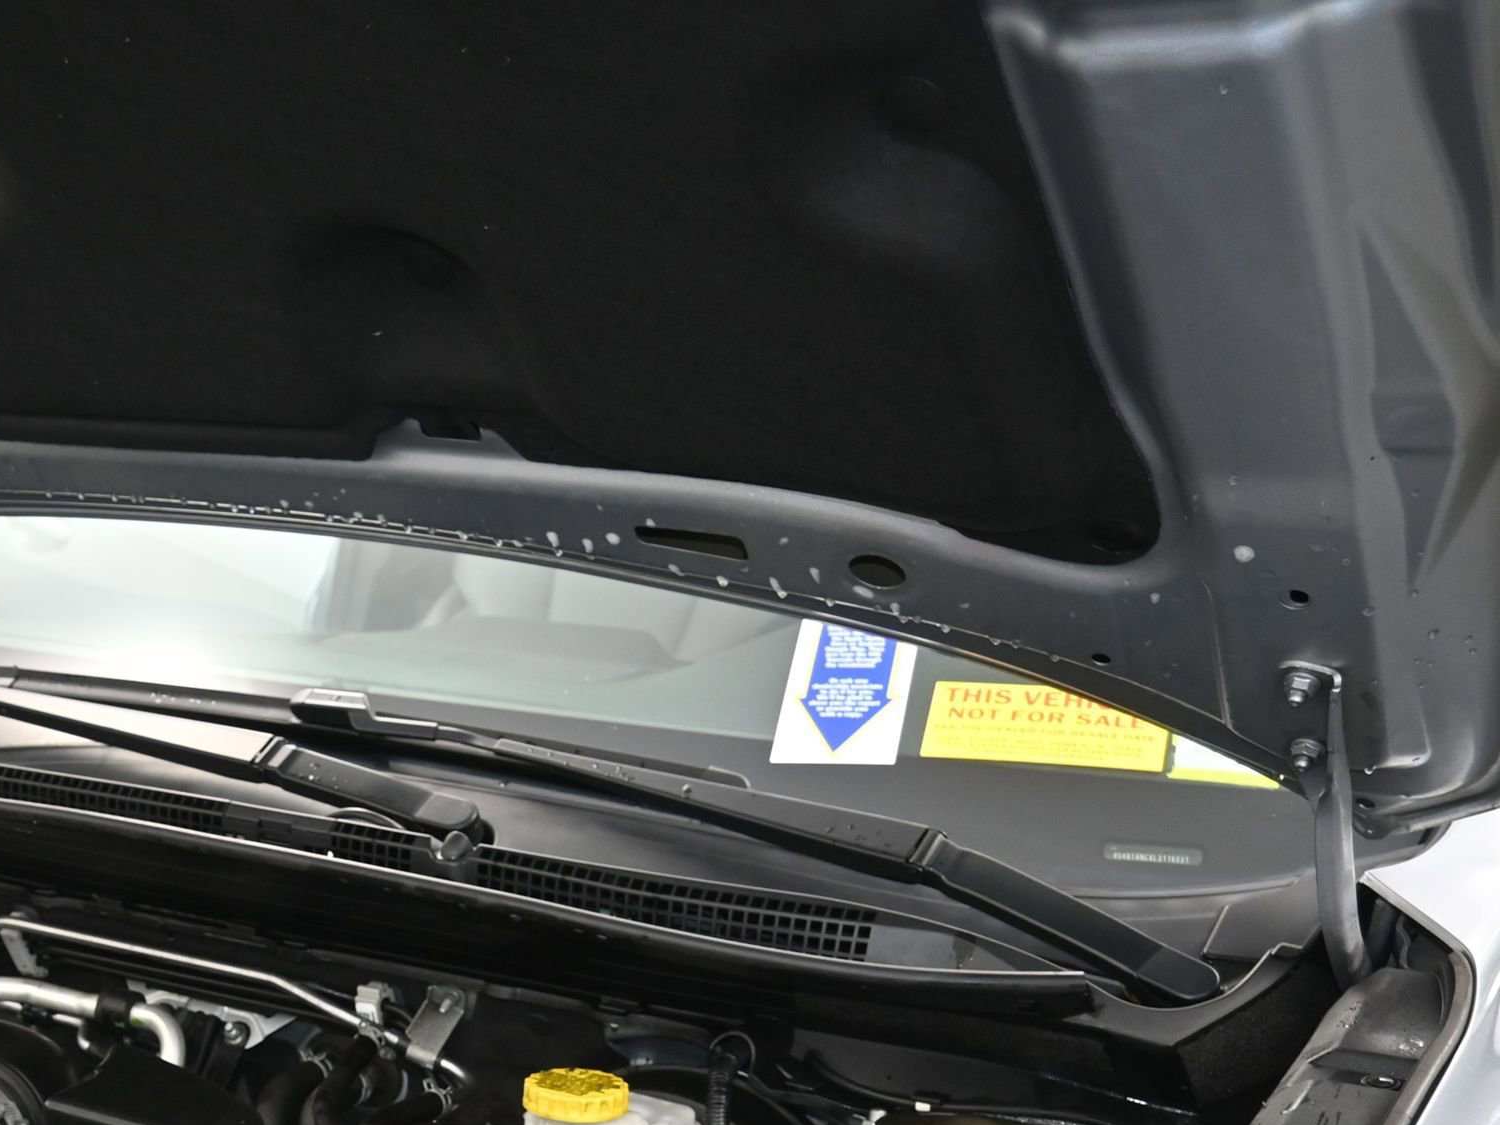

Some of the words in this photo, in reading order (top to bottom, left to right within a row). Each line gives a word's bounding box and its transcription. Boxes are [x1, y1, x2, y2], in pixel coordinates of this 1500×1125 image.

[948, 687, 1012, 705] THIS
[948, 707, 999, 720] NOT
[1011, 709, 1065, 723] FOR
[1075, 713, 1145, 729] SALE
